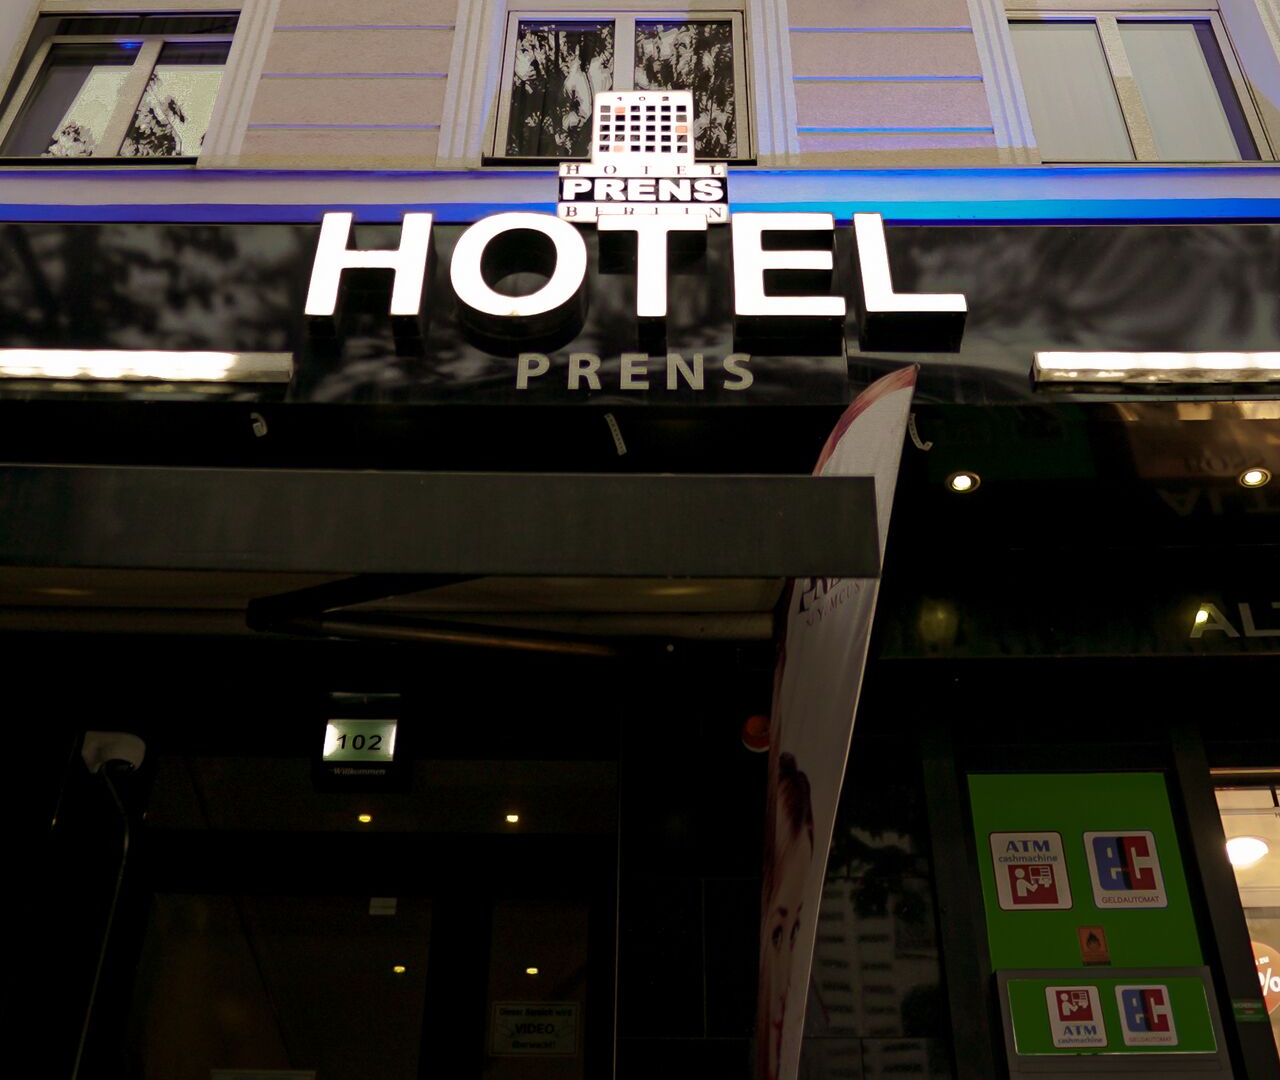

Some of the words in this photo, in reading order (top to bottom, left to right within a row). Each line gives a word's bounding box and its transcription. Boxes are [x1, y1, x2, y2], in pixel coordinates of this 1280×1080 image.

[565, 164, 722, 176] HOTEL
[562, 178, 724, 202] PRENS
[304, 211, 969, 319] HOTEL
[515, 352, 756, 391] PRENS
[336, 734, 383, 751] 102
[1005, 839, 1051, 853] ATM
[998, 853, 1059, 864] cashmachine
[1101, 895, 1160, 905] GELDAUTOMAT
[514, 1023, 555, 1035] VIDEO
[1062, 1025, 1098, 1036] ATM
[1057, 1037, 1104, 1045] cashmachine
